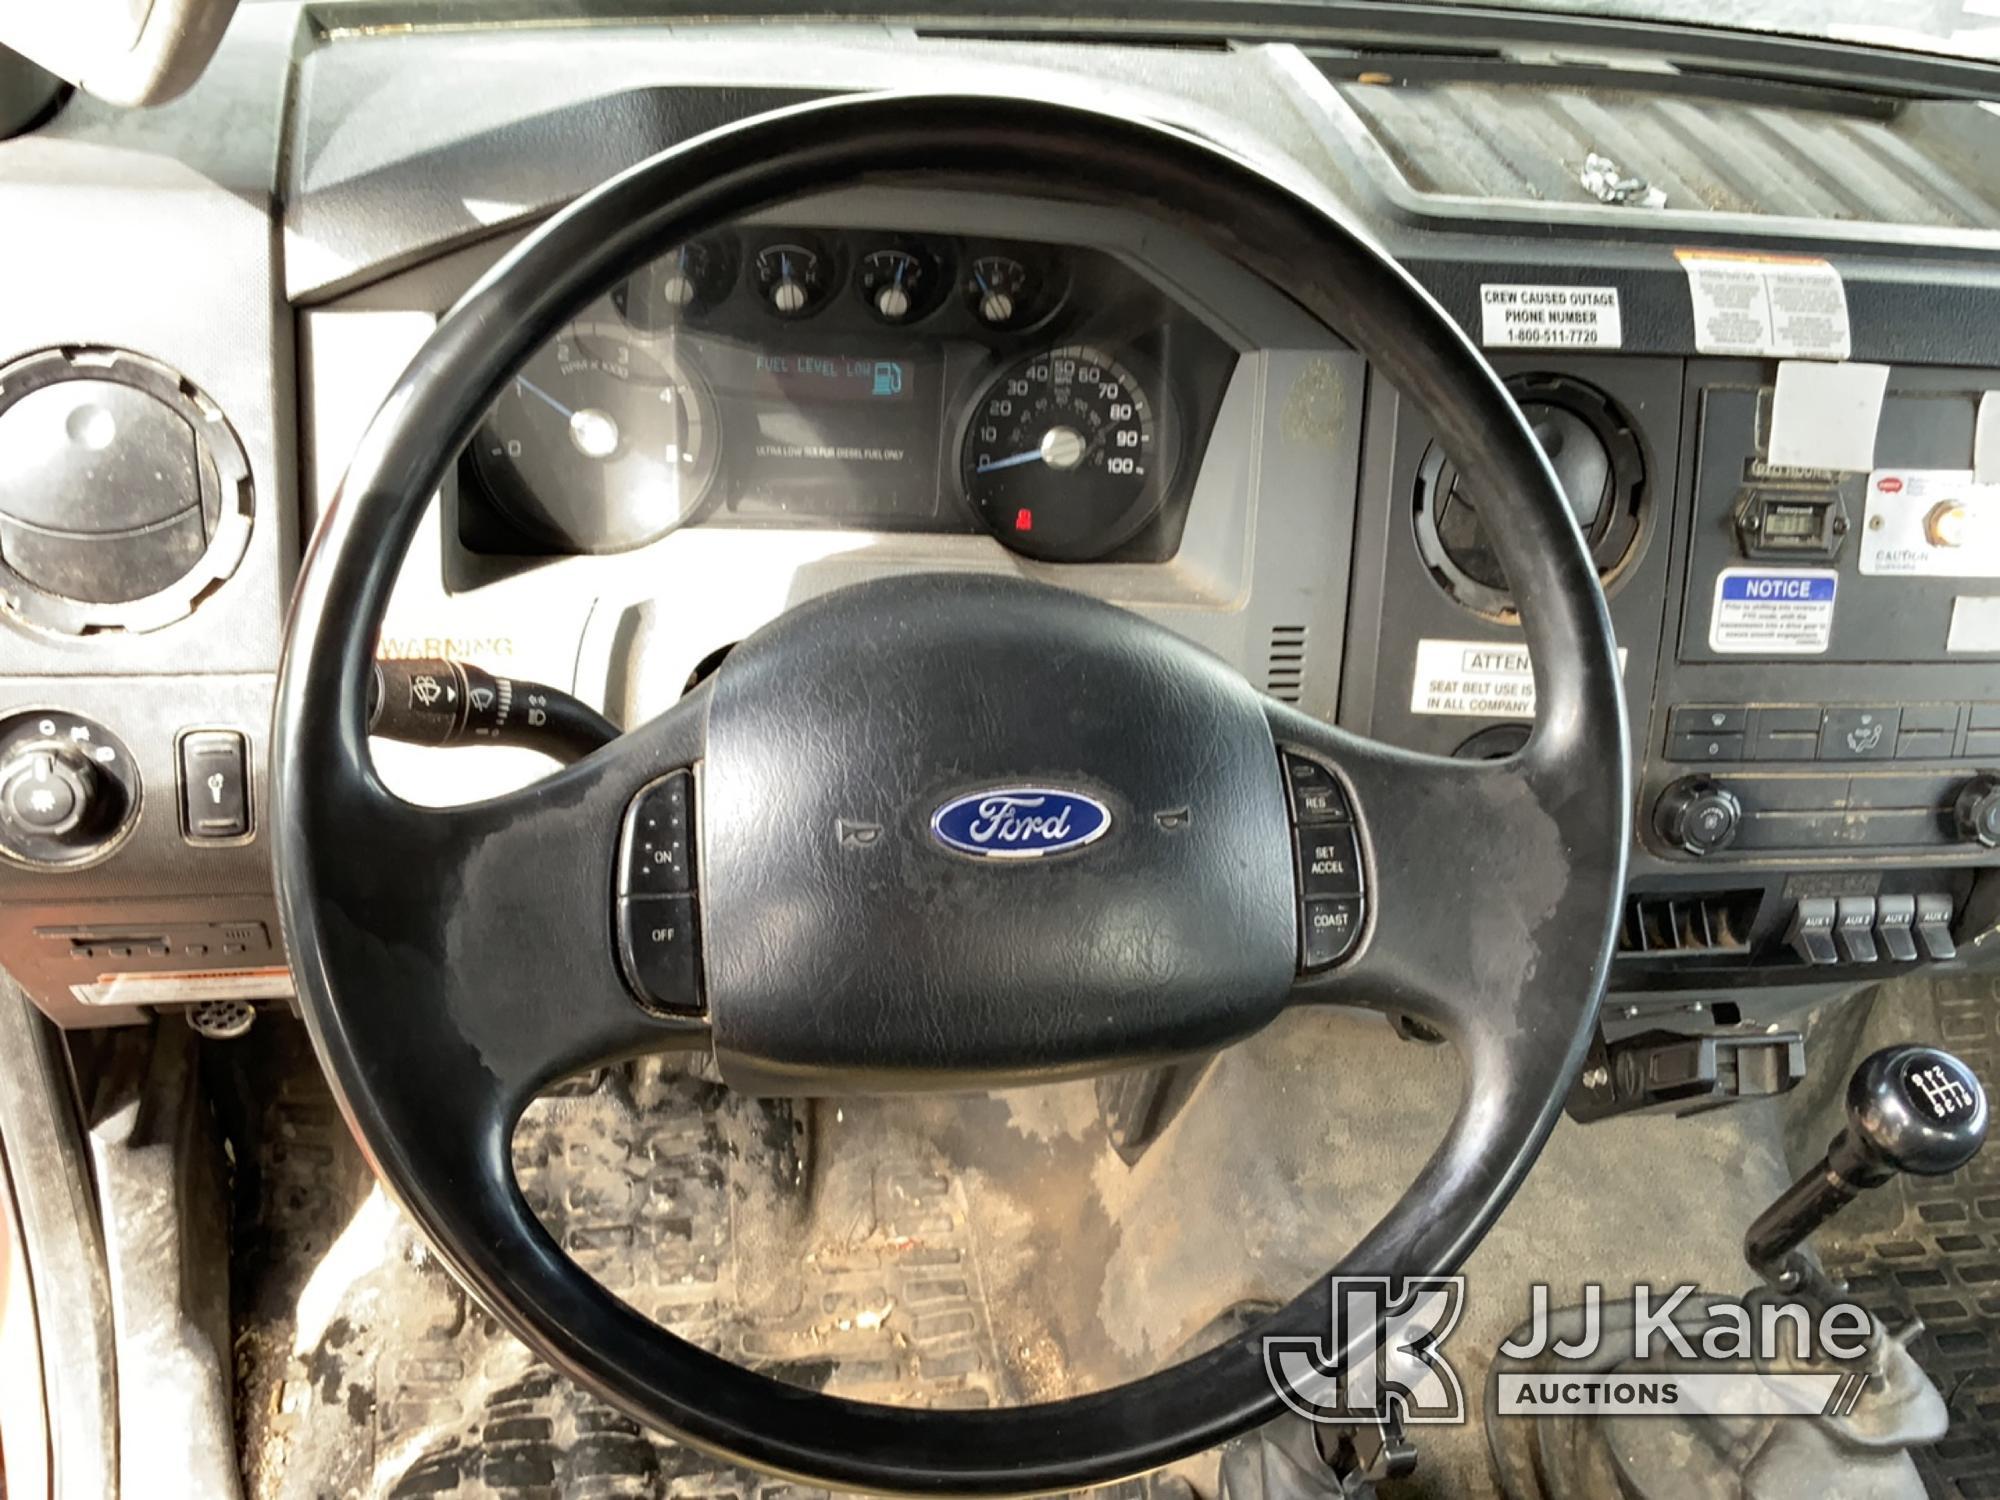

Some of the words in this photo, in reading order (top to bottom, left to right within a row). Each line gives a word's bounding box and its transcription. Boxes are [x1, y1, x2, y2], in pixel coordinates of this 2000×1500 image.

[1484, 291, 1517, 304] CREW
[1521, 291, 1566, 305] CAUSED
[1570, 293, 1614, 307] OUTAGE
[1505, 310, 1544, 323] PHONE
[1548, 311, 1597, 324] NUMBER
[1508, 328, 1598, 342] 1-800-511-7720
[757, 356, 787, 372] FUEL
[798, 358, 834, 377] LEVEL
[847, 361, 870, 377] LOW
[1026, 365, 1048, 382] 40
[1079, 367, 1100, 383] 60
[1008, 380, 1029, 396] 30
[1099, 383, 1118, 399] 70
[990, 400, 1012, 416] 20
[1110, 403, 1132, 420] 80
[981, 427, 997, 442] 10
[1117, 431, 1138, 447] 90
[1107, 458, 1133, 474] 100
[1746, 579, 1811, 598] NOTICE
[1471, 654, 1529, 670] ATTEN
[1429, 680, 1458, 694] SEAT
[1461, 682, 1490, 695] BELT
[1494, 683, 1518, 697] USE
[1521, 685, 1533, 698] IS
[1427, 697, 1439, 710] IN
[1443, 698, 1464, 710] ALL
[1469, 700, 1530, 713] COMPANY
[1306, 797, 1326, 809] RES
[969, 796, 1072, 843] Ford
[654, 851, 672, 864] ON
[1315, 846, 1335, 859] SET
[1311, 861, 1344, 874] ACCEL
[1314, 913, 1348, 927] COAST
[1805, 917, 1826, 926] AUX
[1845, 916, 1863, 925] AUX
[1885, 914, 1903, 923] AUX
[1924, 913, 1942, 921] AUX
[652, 928, 674, 941] OFF
